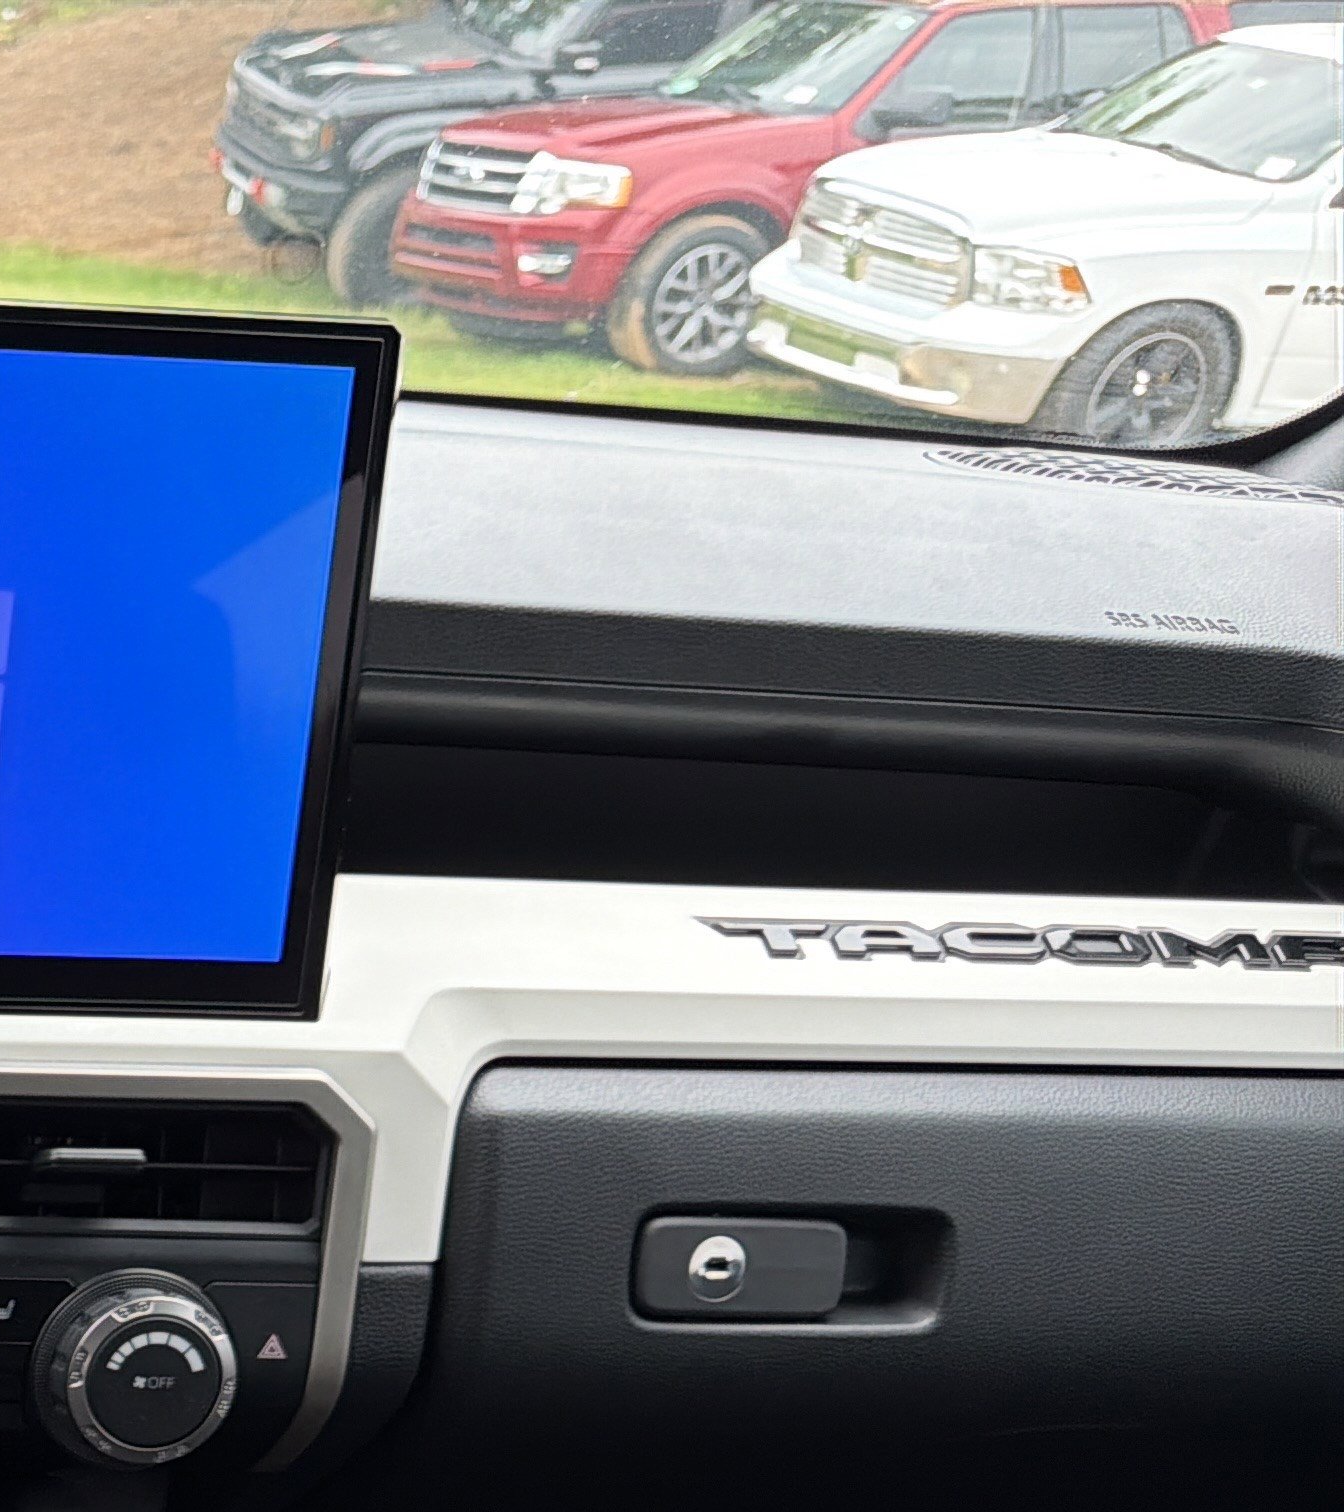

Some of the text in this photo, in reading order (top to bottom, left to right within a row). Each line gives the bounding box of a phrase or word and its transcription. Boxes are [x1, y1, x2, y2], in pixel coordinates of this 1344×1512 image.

[1104, 610, 1241, 636] SRS AIRBAG
[146, 1376, 176, 1390] OFF
